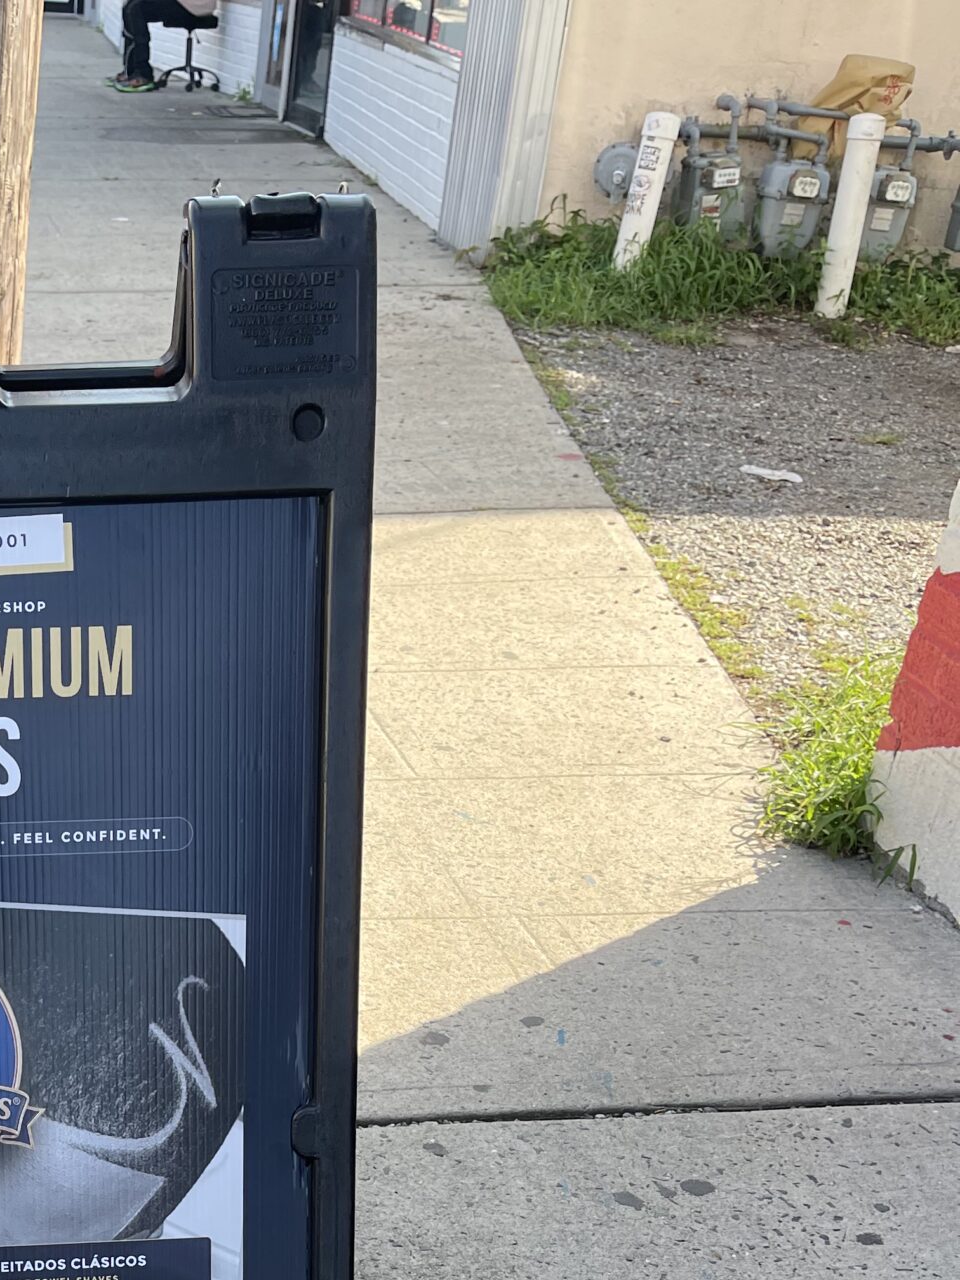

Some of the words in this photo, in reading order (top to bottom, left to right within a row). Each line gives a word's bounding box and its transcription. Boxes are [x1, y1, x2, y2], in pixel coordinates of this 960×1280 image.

[13, 832, 54, 844] FEEL
[61, 828, 167, 843] CONFIDENT.
[70, 1255, 147, 1270] CLÁSICOS
